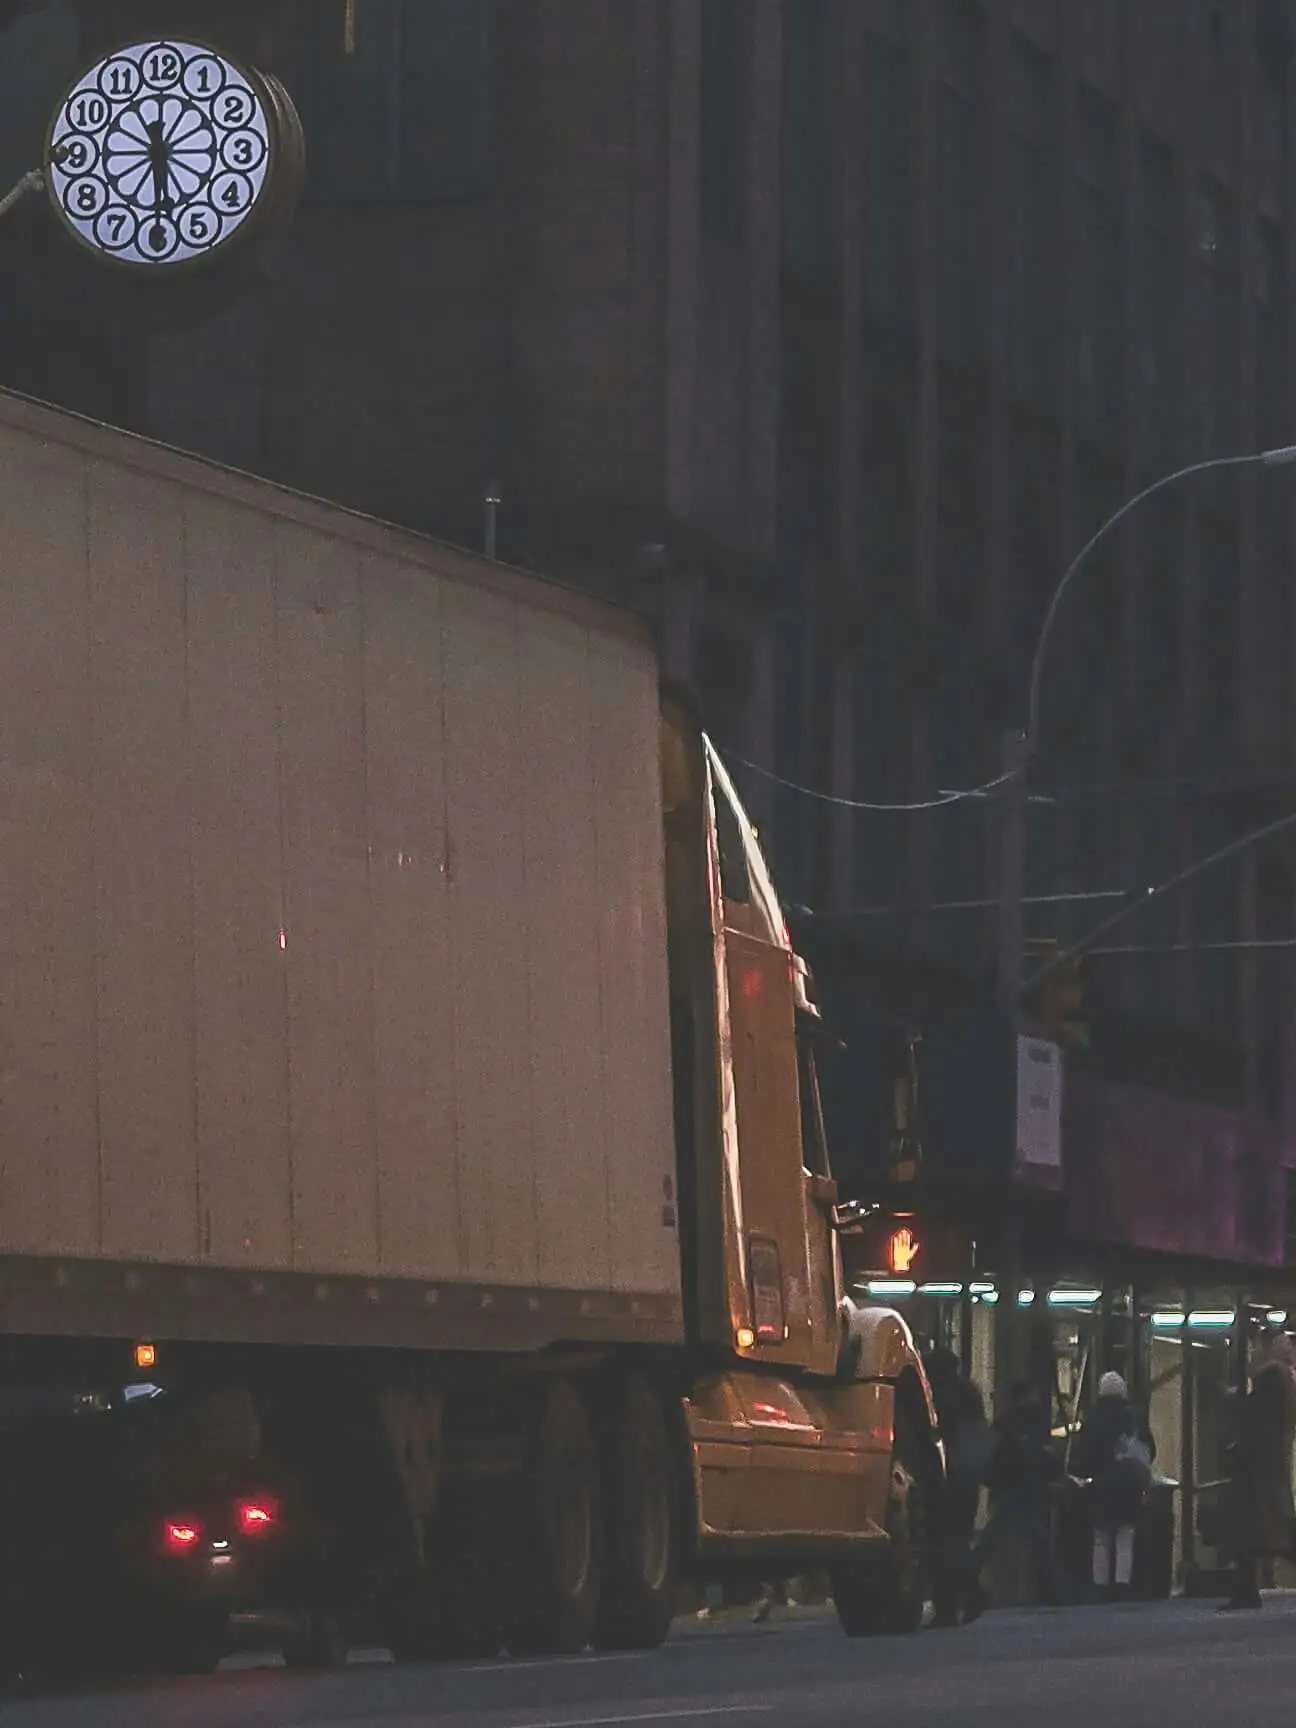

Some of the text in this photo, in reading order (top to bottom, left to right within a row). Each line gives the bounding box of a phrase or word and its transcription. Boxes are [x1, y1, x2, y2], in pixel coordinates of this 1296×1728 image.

[109, 67, 133, 94] 11
[149, 54, 178, 81] 12
[196, 65, 211, 92] 1
[76, 99, 104, 127] 10
[224, 96, 244, 122] 2
[68, 141, 87, 168] 9
[233, 138, 252, 164] 3
[77, 183, 96, 211] 8
[221, 180, 240, 208] 4
[106, 214, 126, 241] 7
[189, 212, 208, 239] 5
